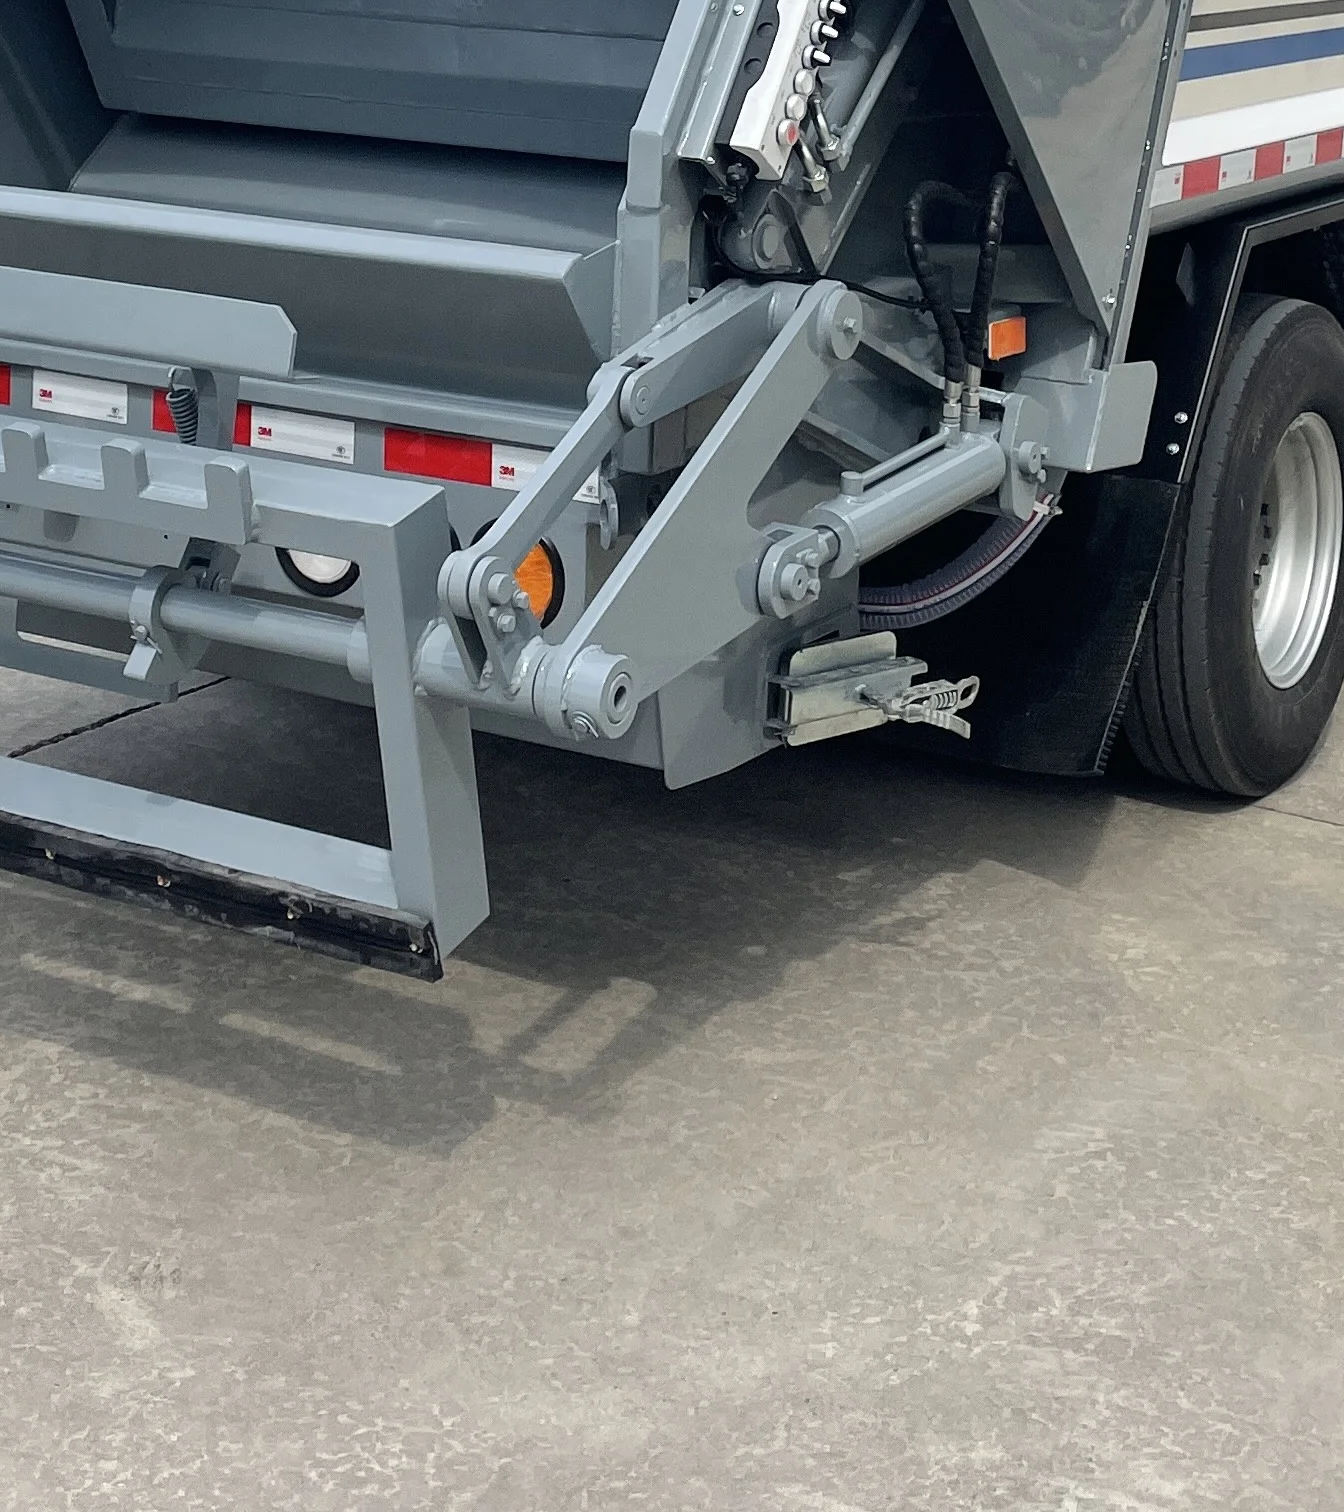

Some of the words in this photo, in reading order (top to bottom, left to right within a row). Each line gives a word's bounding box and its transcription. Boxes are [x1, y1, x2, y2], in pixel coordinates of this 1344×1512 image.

[39, 388, 53, 399] 3M
[257, 426, 272, 437] 3M
[499, 465, 515, 476] 3M
